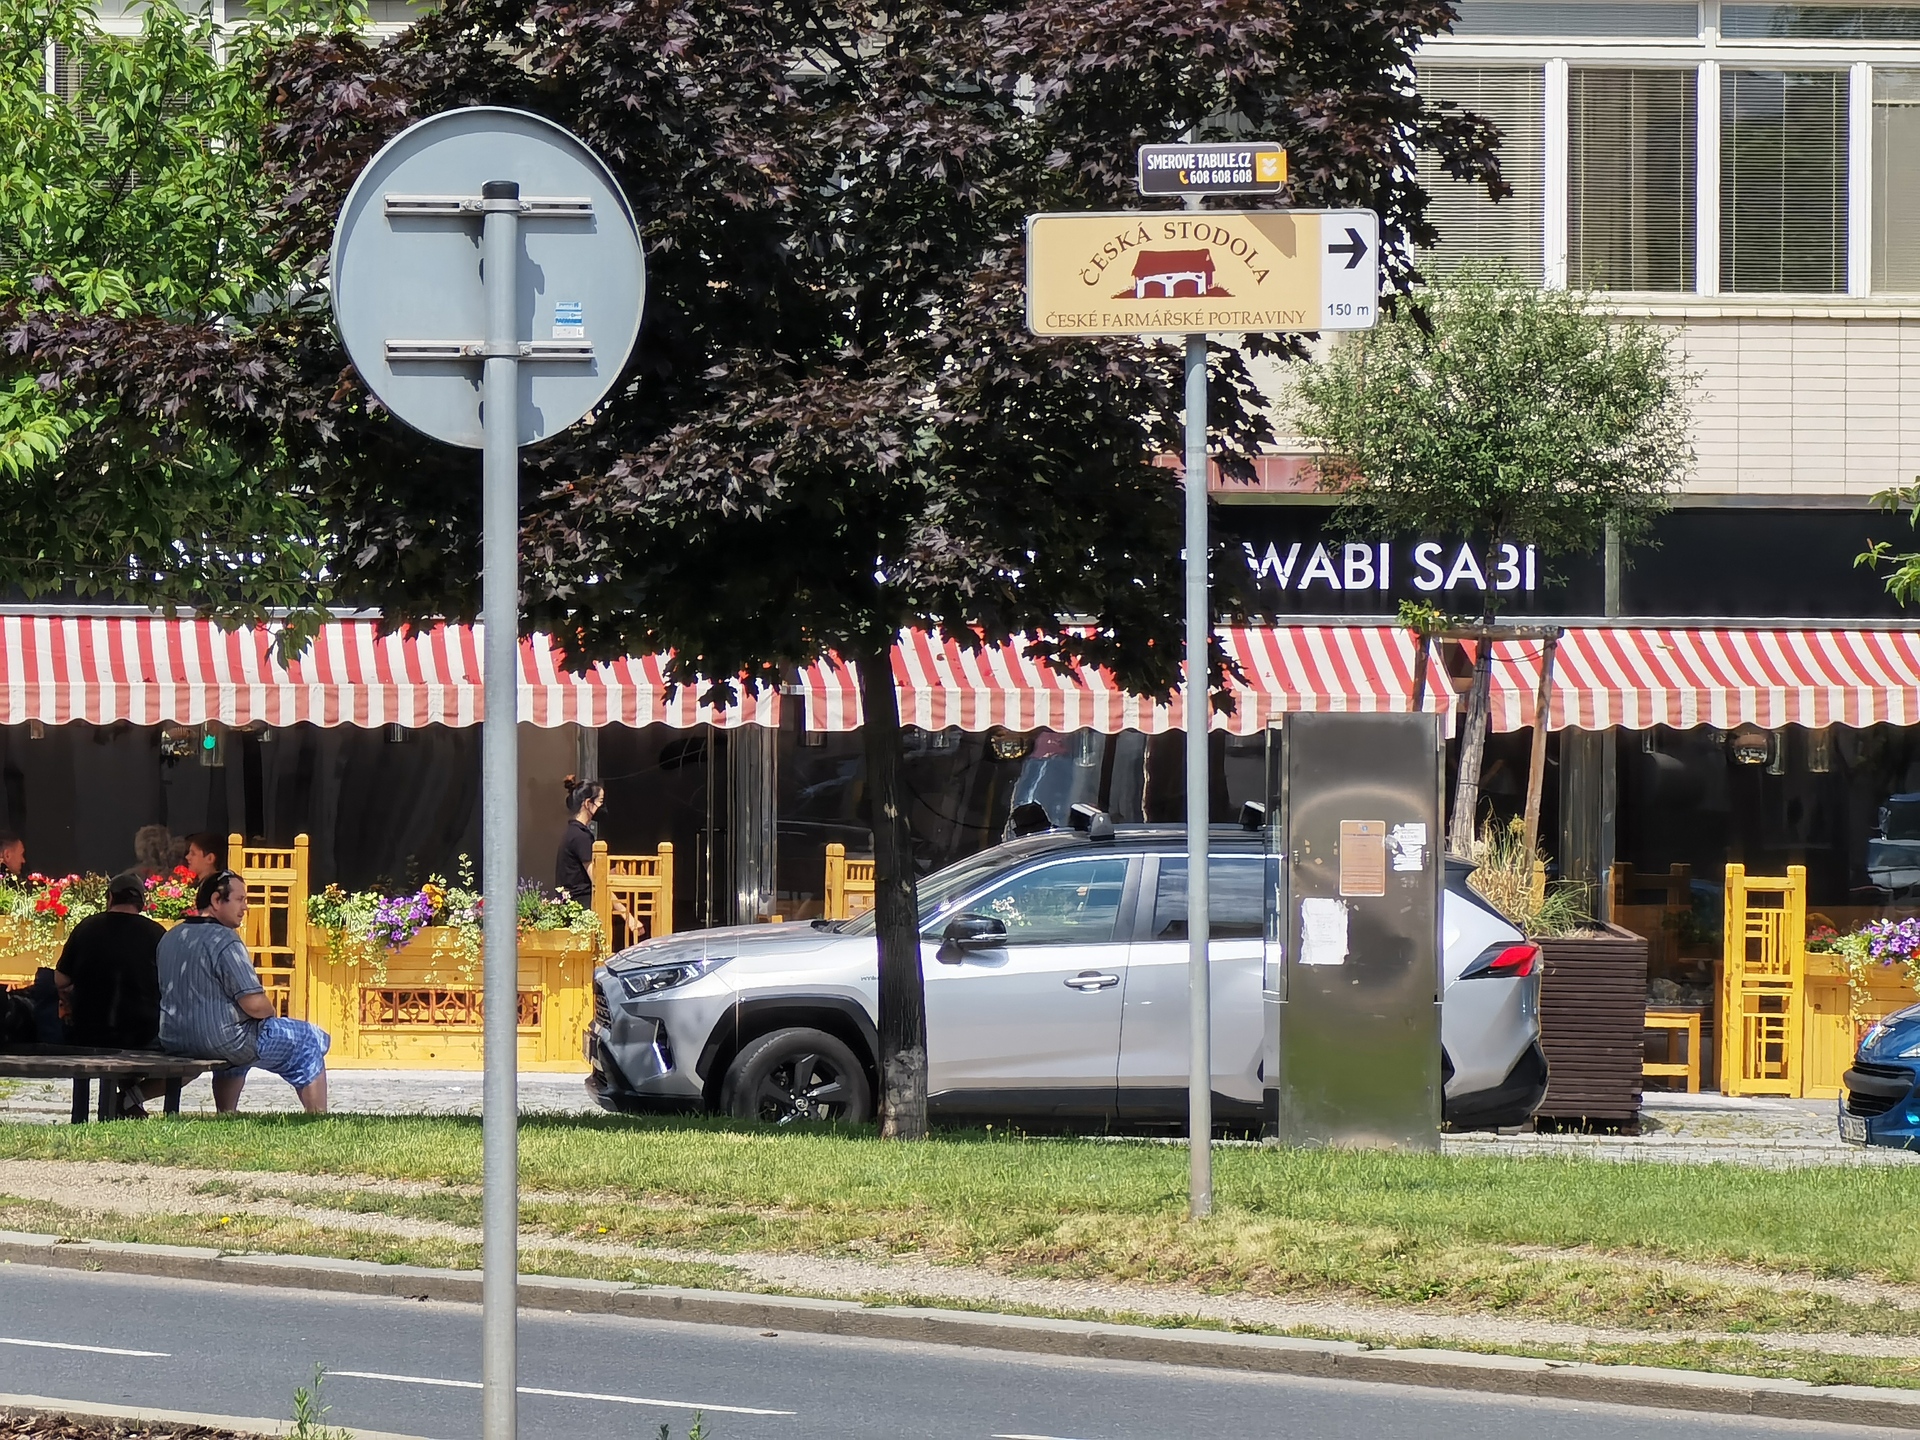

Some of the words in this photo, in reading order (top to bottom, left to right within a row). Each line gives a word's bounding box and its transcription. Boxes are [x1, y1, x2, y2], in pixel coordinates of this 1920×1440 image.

[1147, 153, 1196, 170] SMEROVE
[1196, 152, 1252, 169] TABULE.CZ
[1189, 169, 1210, 184] 608
[1211, 169, 1231, 184] 608
[1232, 168, 1253, 183] 608
[1078, 221, 1153, 287] ČESKÁ
[1163, 221, 1270, 286] STODOLA
[1045, 309, 1099, 328] ČESKÉ
[1102, 308, 1204, 327] FARMÁŘSKÉ
[1208, 310, 1307, 326] POTRAVINY
[1327, 303, 1352, 316] 150
[1356, 305, 1370, 316] m
[1242, 541, 1389, 591] WABI
[1413, 541, 1536, 591] SABI
